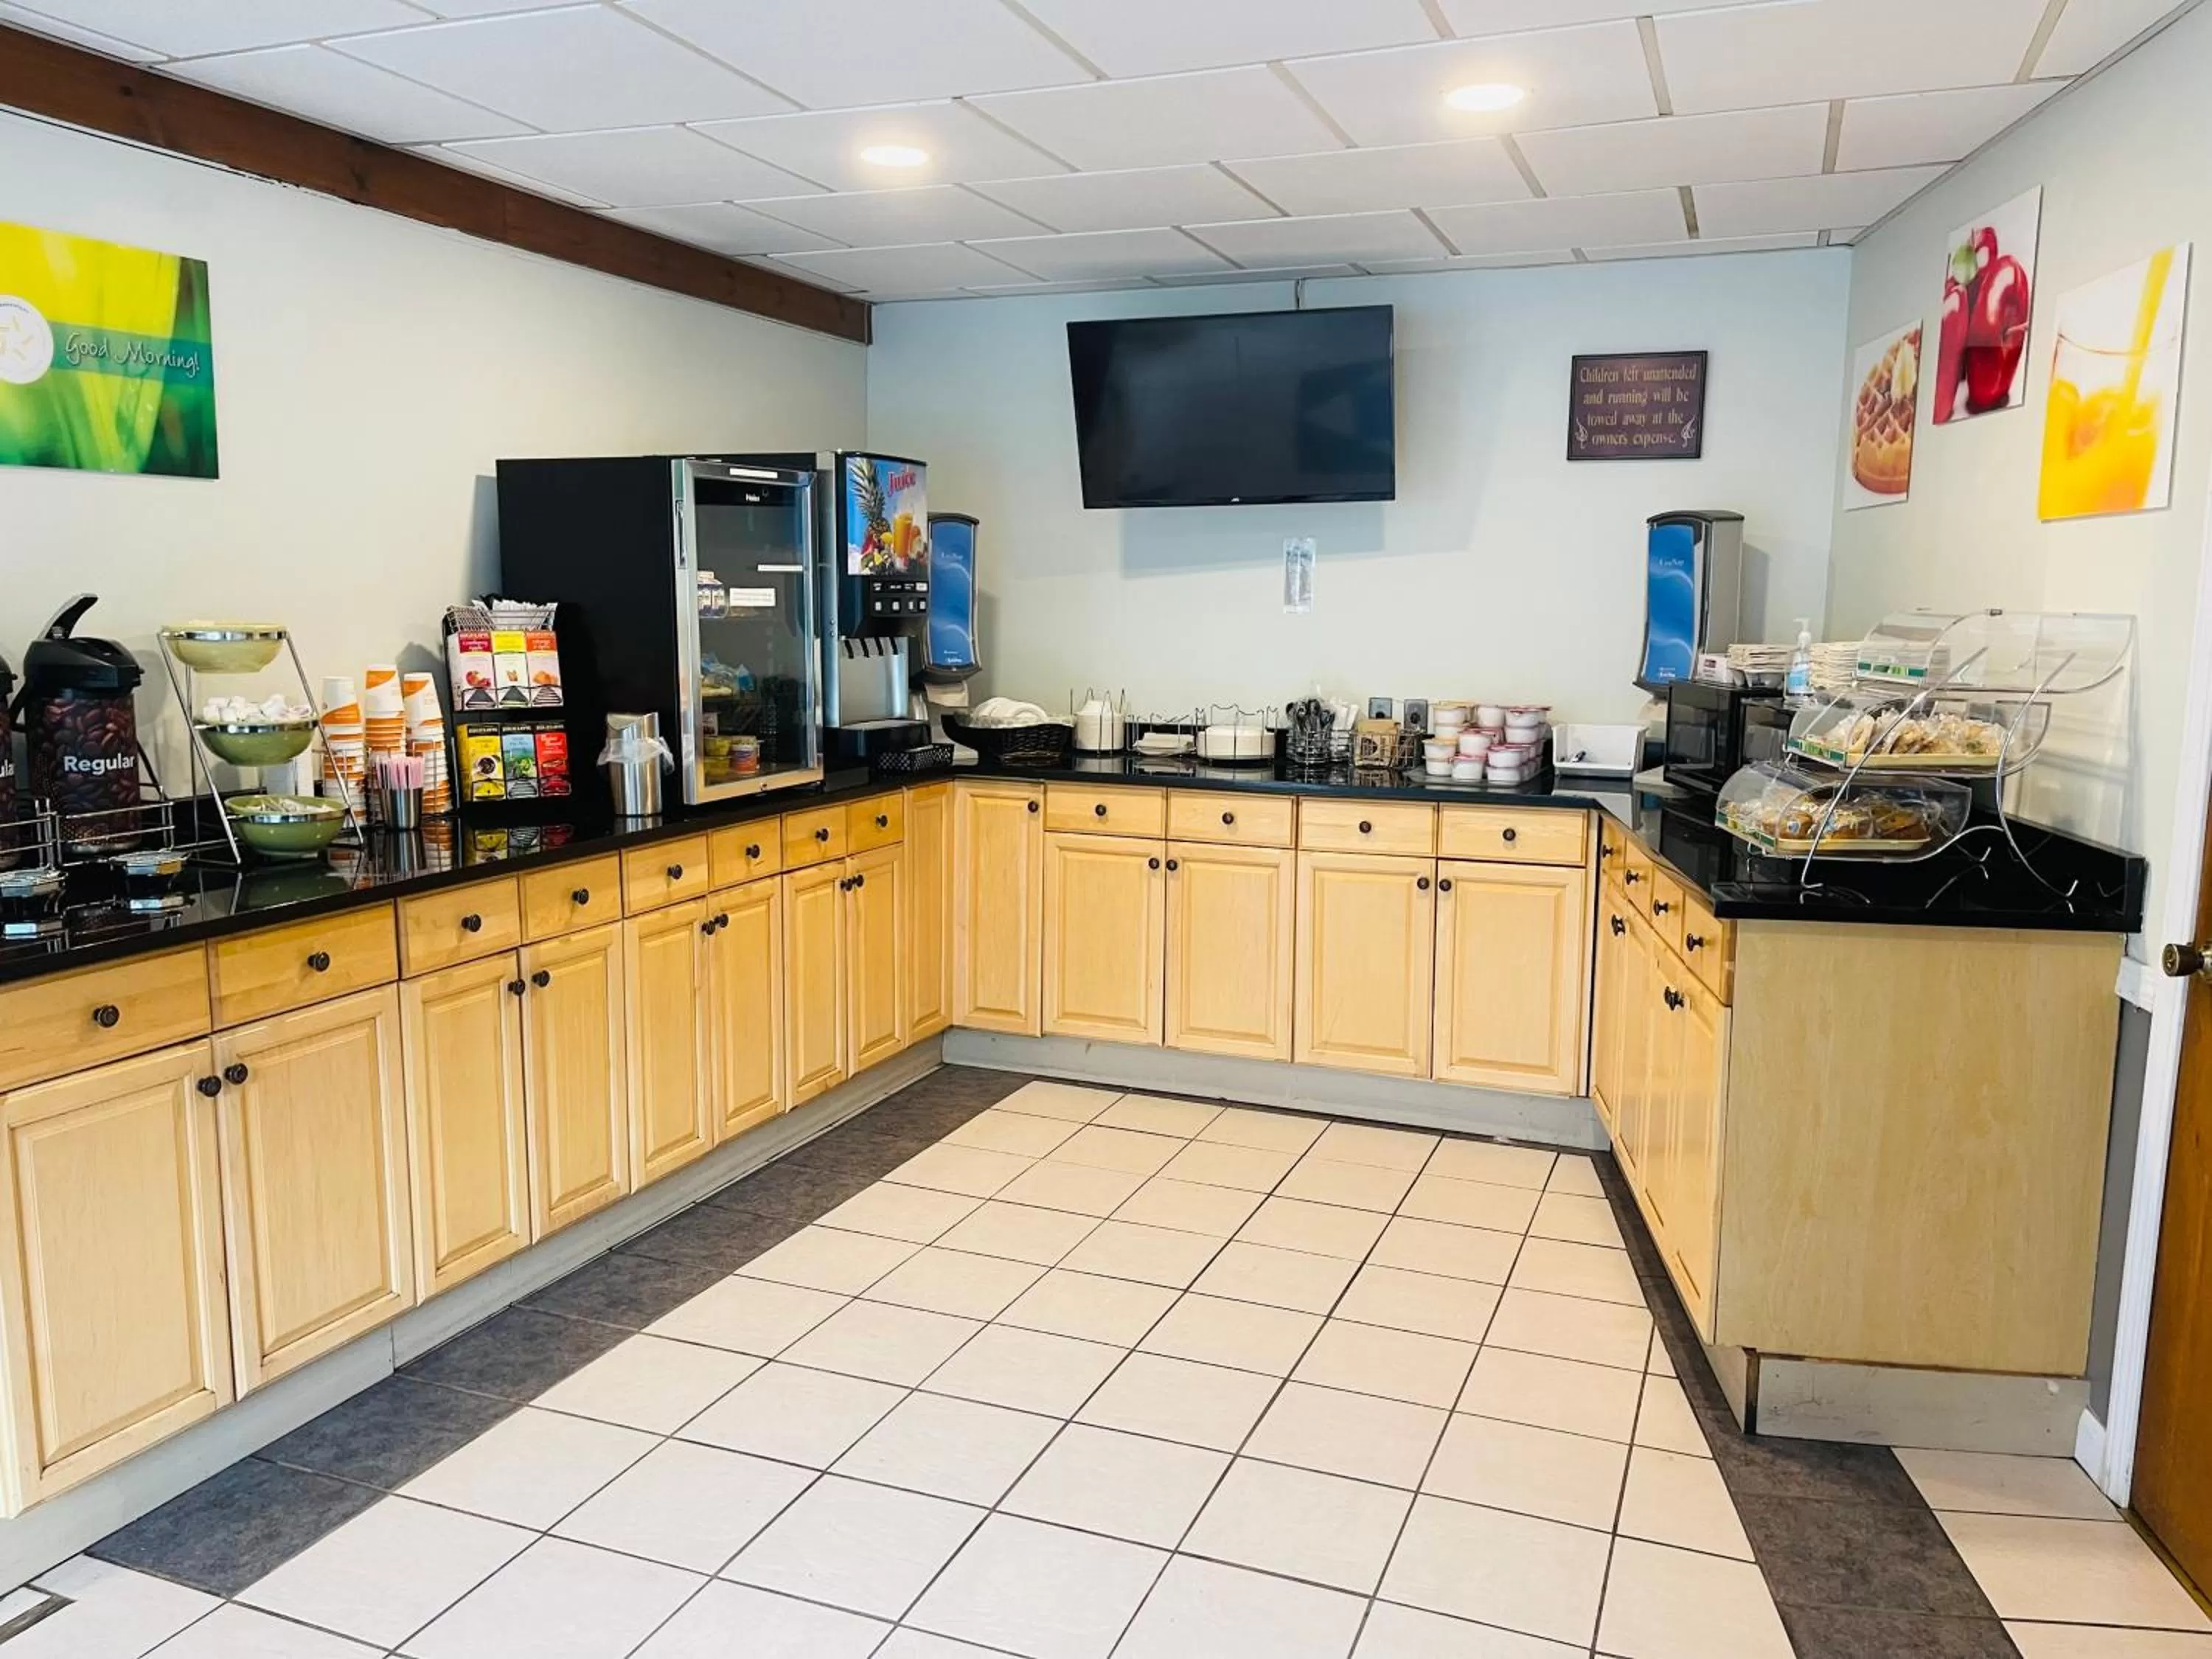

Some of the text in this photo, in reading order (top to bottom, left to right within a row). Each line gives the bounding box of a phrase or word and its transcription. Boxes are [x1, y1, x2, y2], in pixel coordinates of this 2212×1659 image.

[66, 332, 200, 378] Good Morning!
[1580, 364, 1697, 383] Children left unattended
[1583, 386, 1690, 407] and running will be
[1587, 408, 1684, 428] towed away at the
[63, 752, 136, 776] Regular
